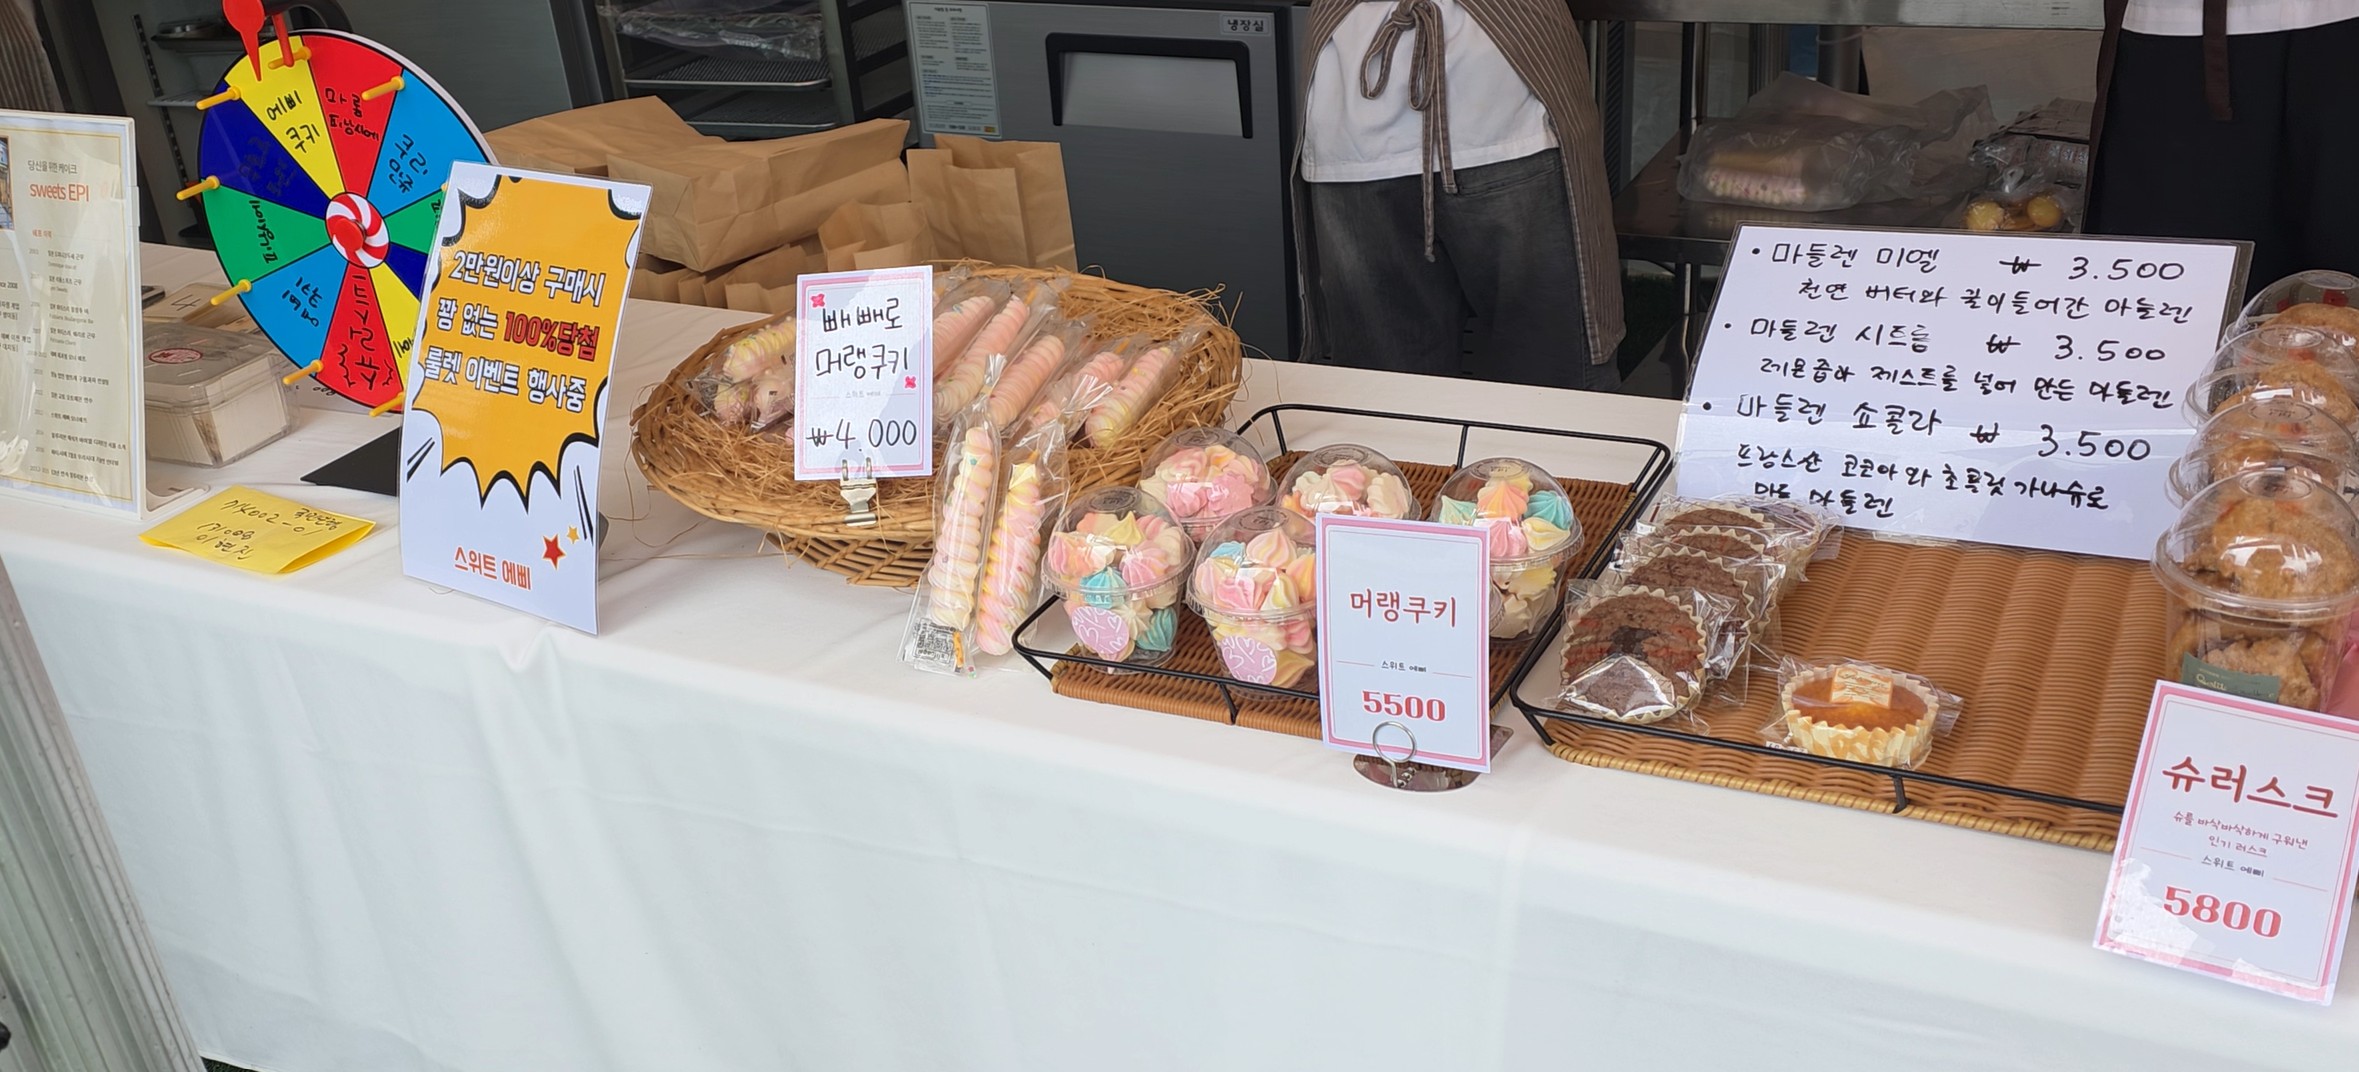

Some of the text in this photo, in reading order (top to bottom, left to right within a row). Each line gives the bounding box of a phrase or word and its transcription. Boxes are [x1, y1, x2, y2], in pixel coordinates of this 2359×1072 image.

[1227, 19, 1264, 32] 냉장실
[285, 123, 321, 154] 쿠키
[28, 160, 48, 172] 당신을
[58, 163, 78, 174] 케이크
[29, 183, 90, 202] sweets EPI
[449, 250, 606, 307] 2만원이상 구매시
[1772, 243, 1858, 268] 마들렌
[1876, 247, 1940, 273] 미엘
[2068, 256, 2185, 280] 3.500
[1798, 278, 1849, 300] 천연
[1865, 285, 1948, 307] 버터와
[436, 297, 600, 362] 꽝 없는 100%당첨
[823, 298, 903, 333] 빼빼로
[1750, 318, 1837, 343] 마들렌
[2054, 335, 2166, 361] 3.500
[425, 345, 463, 385] 룰렛
[465, 356, 520, 396] 이벤트
[527, 368, 587, 413] 행사중
[816, 344, 909, 379] 머랭쿠키
[1870, 364, 1959, 392] 제스트를
[2034, 377, 2075, 401] 만든
[1737, 393, 1826, 425] 마들렌
[1852, 402, 1942, 435] 쇼콜라
[2038, 424, 2151, 461] 3.500
[1737, 443, 1823, 473] 프랑스산
[2014, 477, 2108, 509] 가나슈로
[454, 546, 531, 591] 스위트 에삐
[1350, 588, 1456, 627] 머랭쿠키
[1381, 660, 1406, 671] 스위트
[1362, 690, 1446, 722] 5500
[2162, 756, 2339, 818] 슈러스크
[2173, 811, 2309, 850] 슈를 바삭바삭하게 구워낸
[2208, 835, 2268, 858] 인기 러스크
[2201, 855, 2235, 871] 스위트
[2163, 886, 2283, 938] 5800
